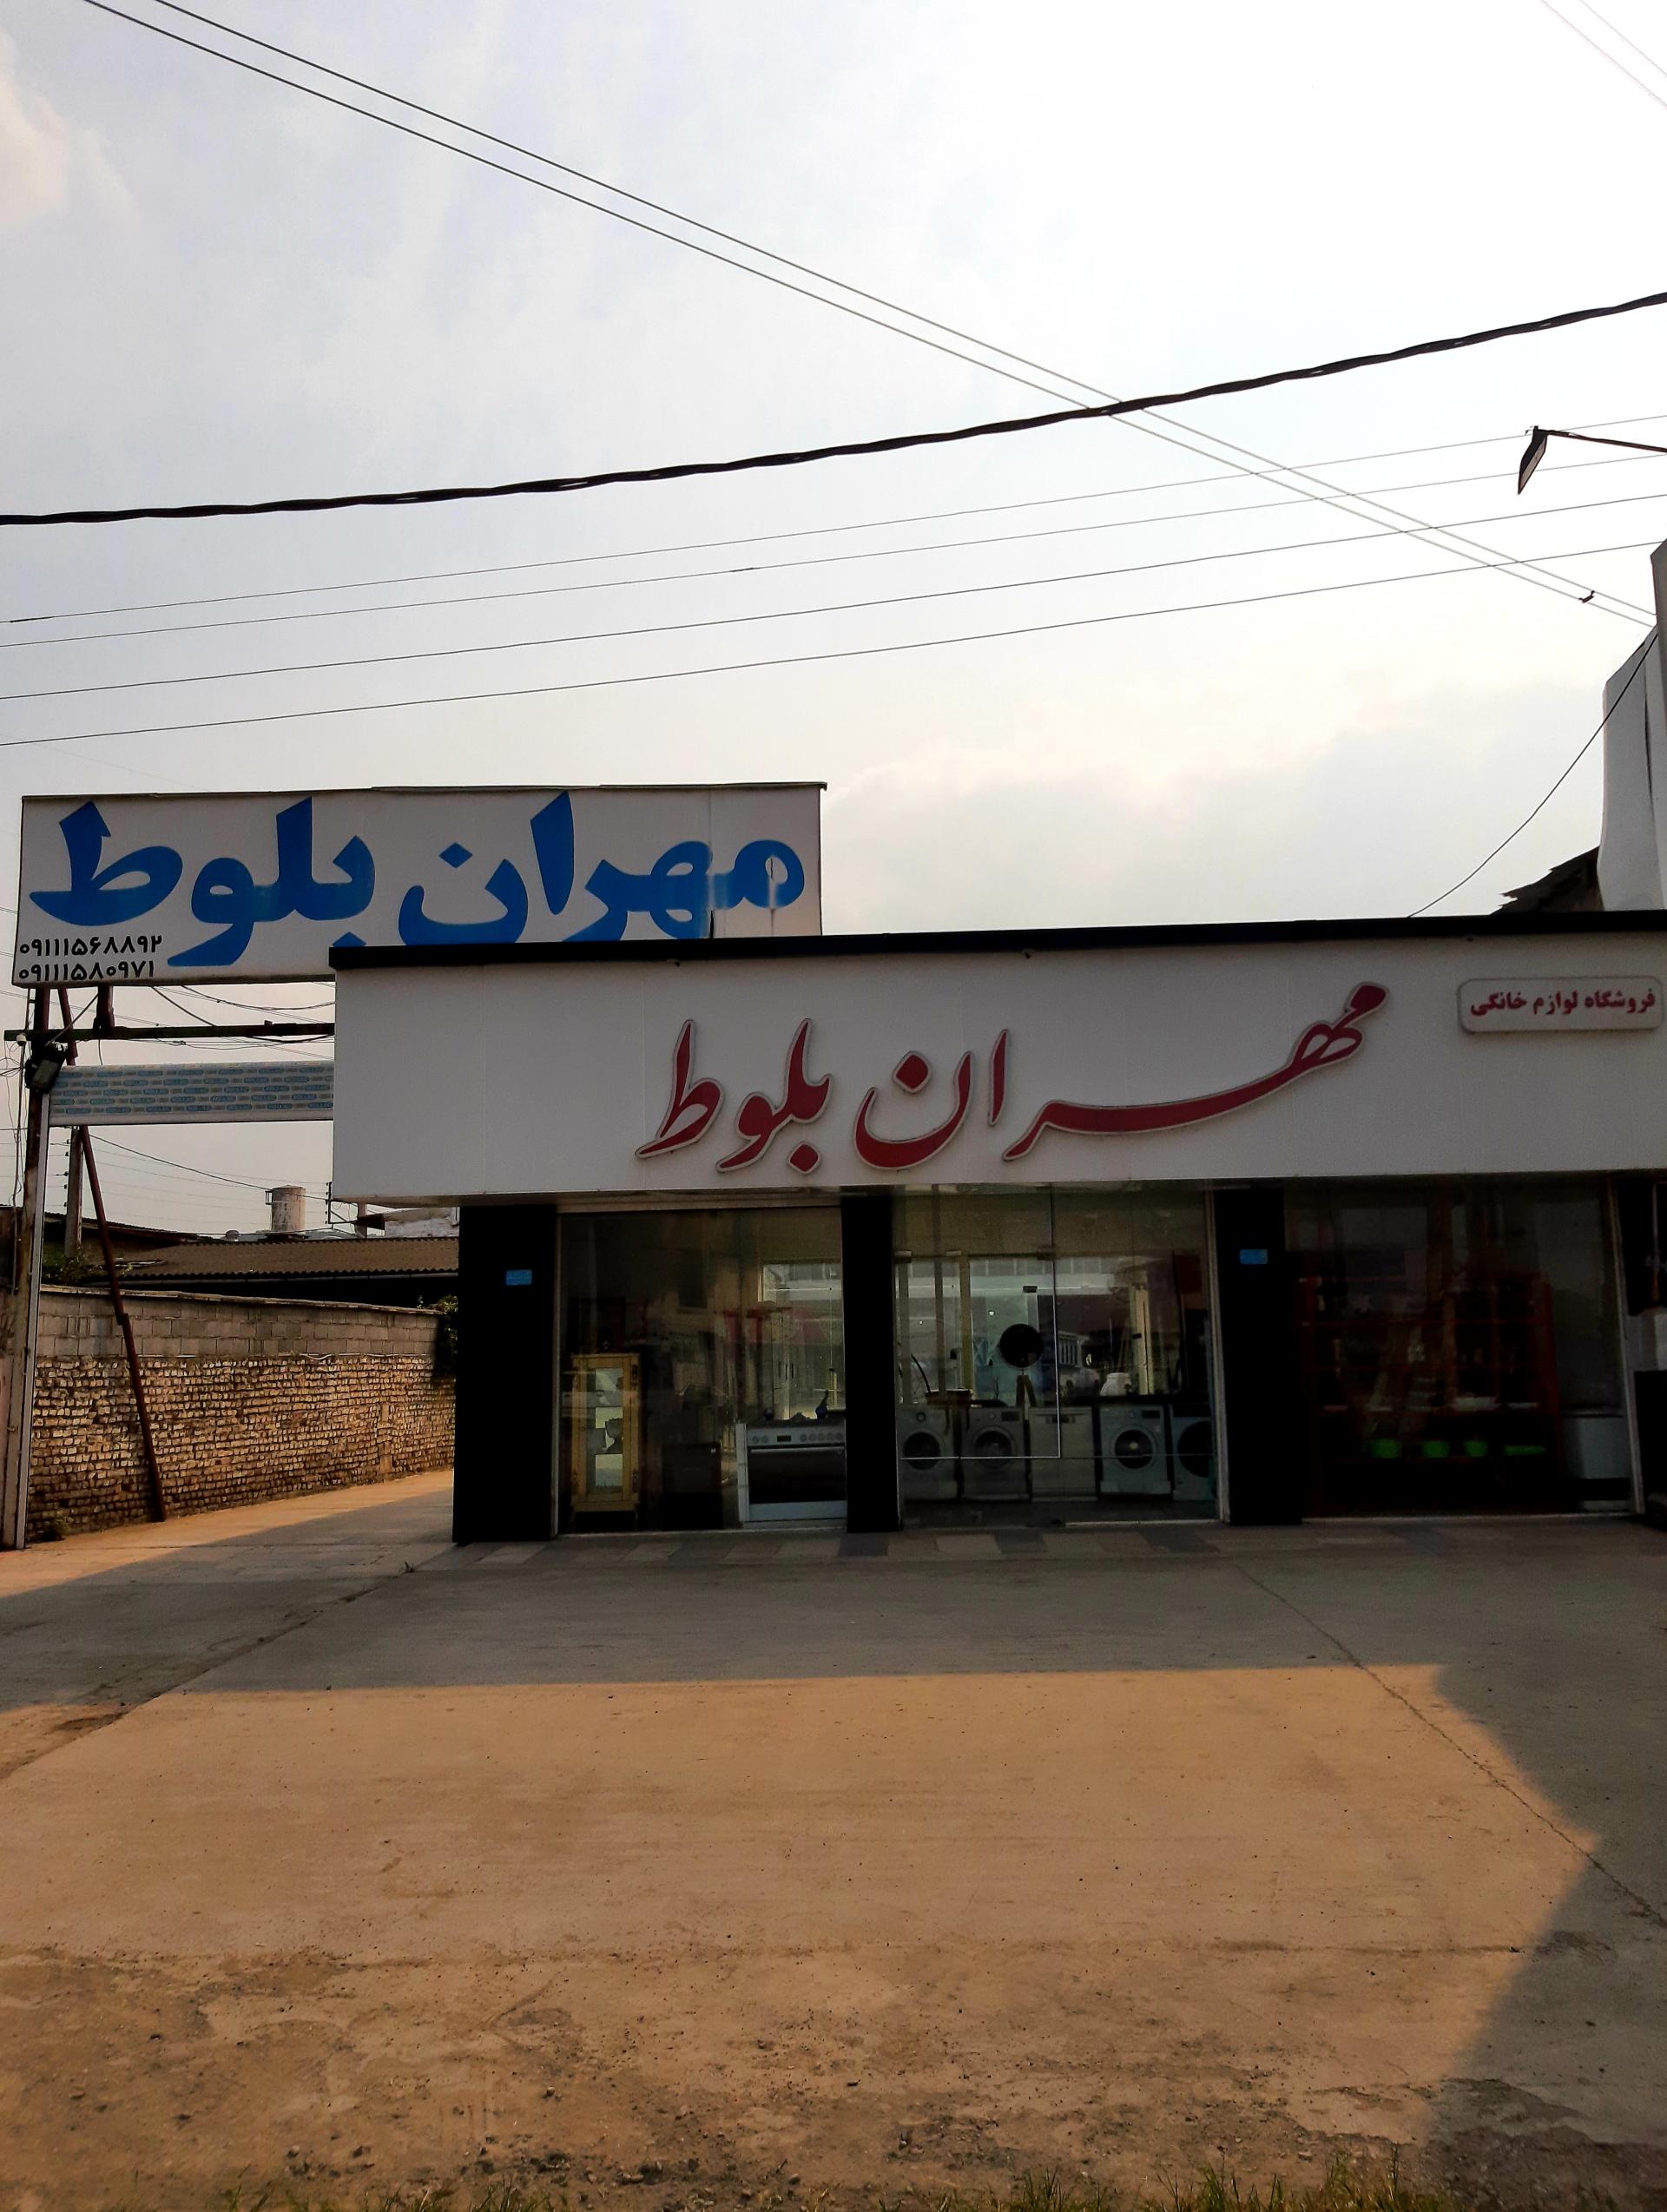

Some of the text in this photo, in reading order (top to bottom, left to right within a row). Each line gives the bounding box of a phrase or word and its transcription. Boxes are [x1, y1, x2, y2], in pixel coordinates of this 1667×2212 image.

[30, 792, 805, 967] مهران بلوط
[19, 935, 162, 957] ۰۹۱۱۱۵۶۸۸۹۲
[18, 960, 155, 982] ۰۹۱۱۱۵۸۰۹۷۱
[1470, 988, 1657, 1017] فروشگاه لوازم خانگی
[635, 982, 1390, 1175] مهران بلوط
